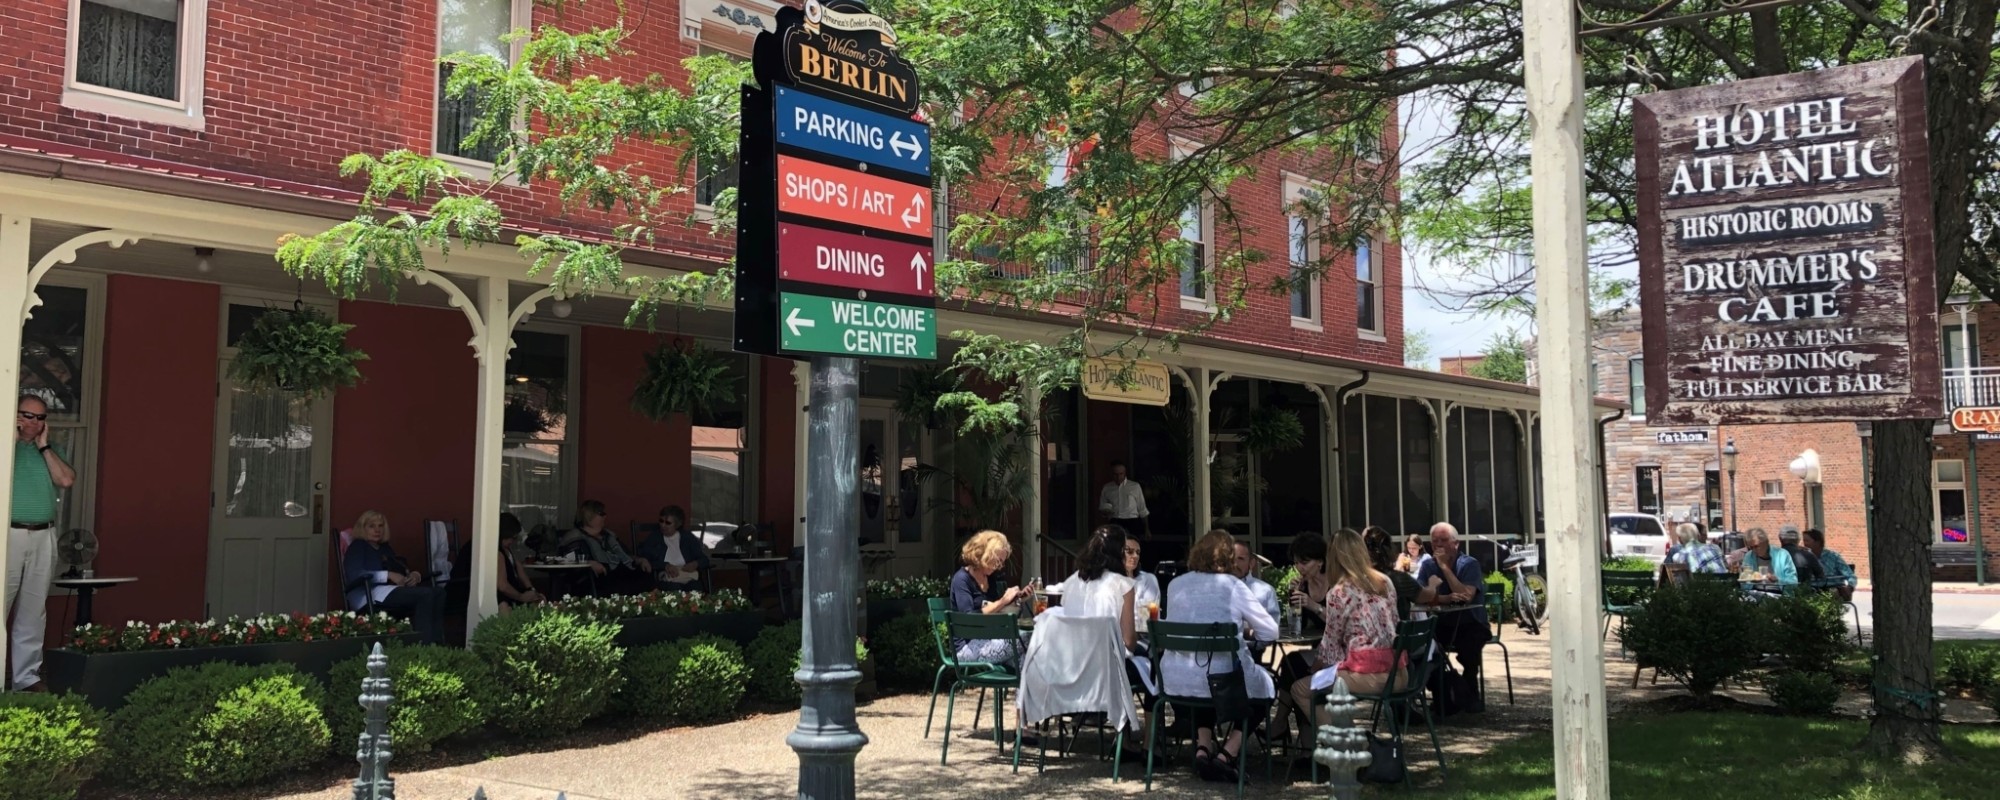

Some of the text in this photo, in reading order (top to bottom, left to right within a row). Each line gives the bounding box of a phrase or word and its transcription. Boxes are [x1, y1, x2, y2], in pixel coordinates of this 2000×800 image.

[823, 9, 849, 27] America's
[869, 17, 883, 29] Small
[821, 33, 888, 67] Welcome To
[799, 43, 908, 103] BERLIN
[795, 107, 884, 150] PARKING
[1694, 97, 1857, 150] HOTEL
[1668, 137, 1892, 196] ATLANTIC
[786, 172, 895, 216] SHOPS / ART
[1681, 201, 1873, 239] HISTORIC ROOMS
[816, 245, 885, 278] DINING
[1683, 250, 1878, 292] DRUMMER'S
[831, 301, 926, 331] WELCOME
[843, 329, 918, 356] CENTER
[1701, 334, 1740, 351] ALL
[1745, 330, 1789, 349] DAY
[1710, 350, 1855, 374] FINE DINING
[1121, 368, 1164, 392] LANTIC
[1686, 373, 1885, 398] FULL SERVICE BAR
[1659, 432, 1708, 443] fathom.
